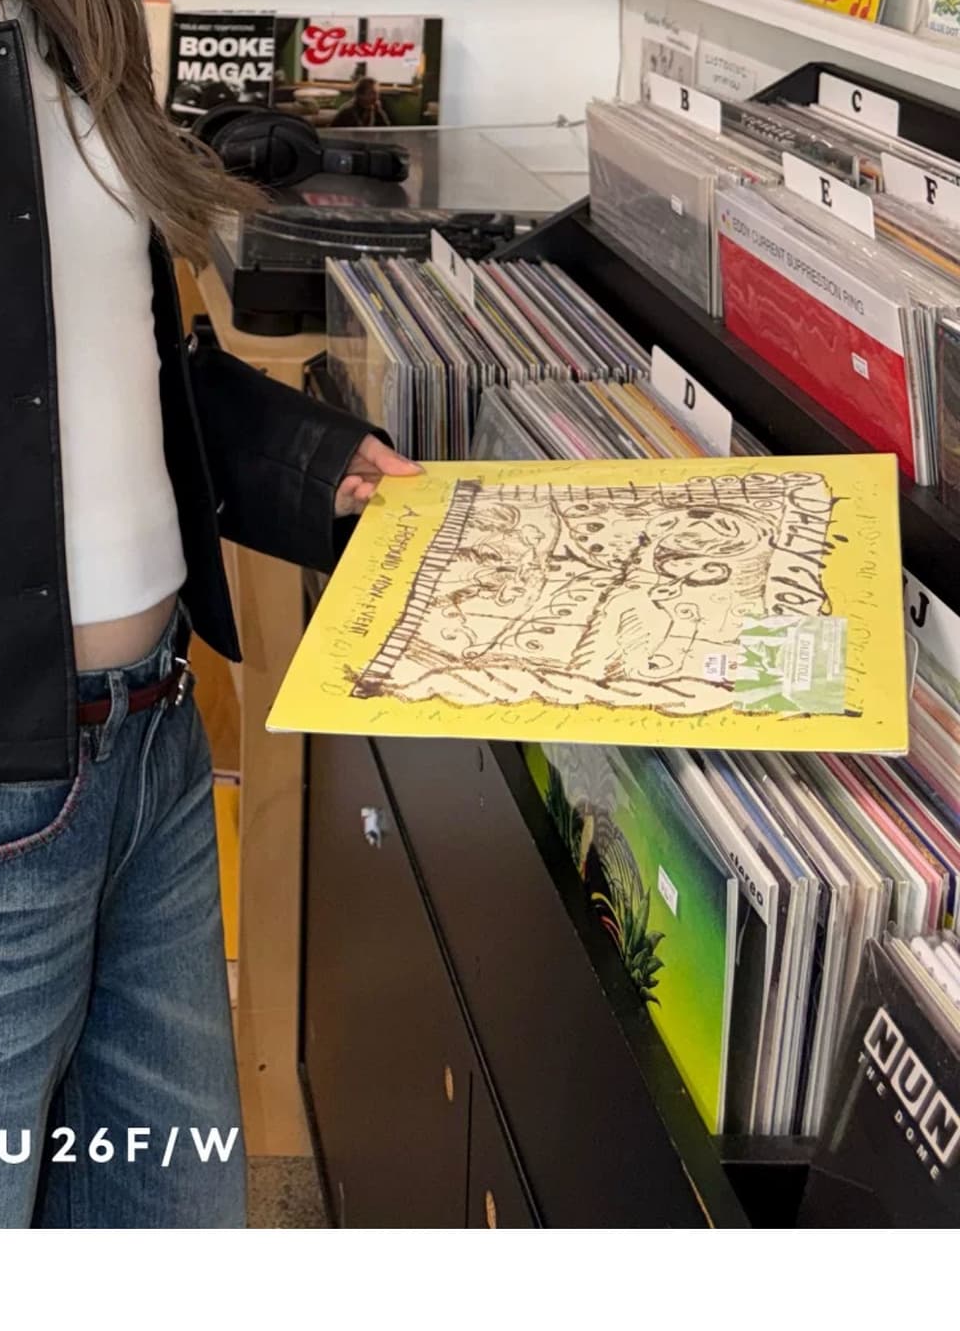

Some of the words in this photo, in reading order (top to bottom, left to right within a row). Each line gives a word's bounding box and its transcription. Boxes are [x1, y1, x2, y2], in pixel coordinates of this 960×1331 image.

[179, 36, 275, 57] BOOKE
[177, 61, 274, 81] MAGAZ
[679, 88, 689, 111] B
[851, 90, 862, 113] C
[819, 176, 833, 207] E
[924, 175, 939, 205] F
[683, 380, 696, 411] D
[909, 590, 930, 628] J
[865, 1009, 960, 1161] NUN
[857, 1051, 886, 1097] THE
[894, 1108, 940, 1181] DOME
